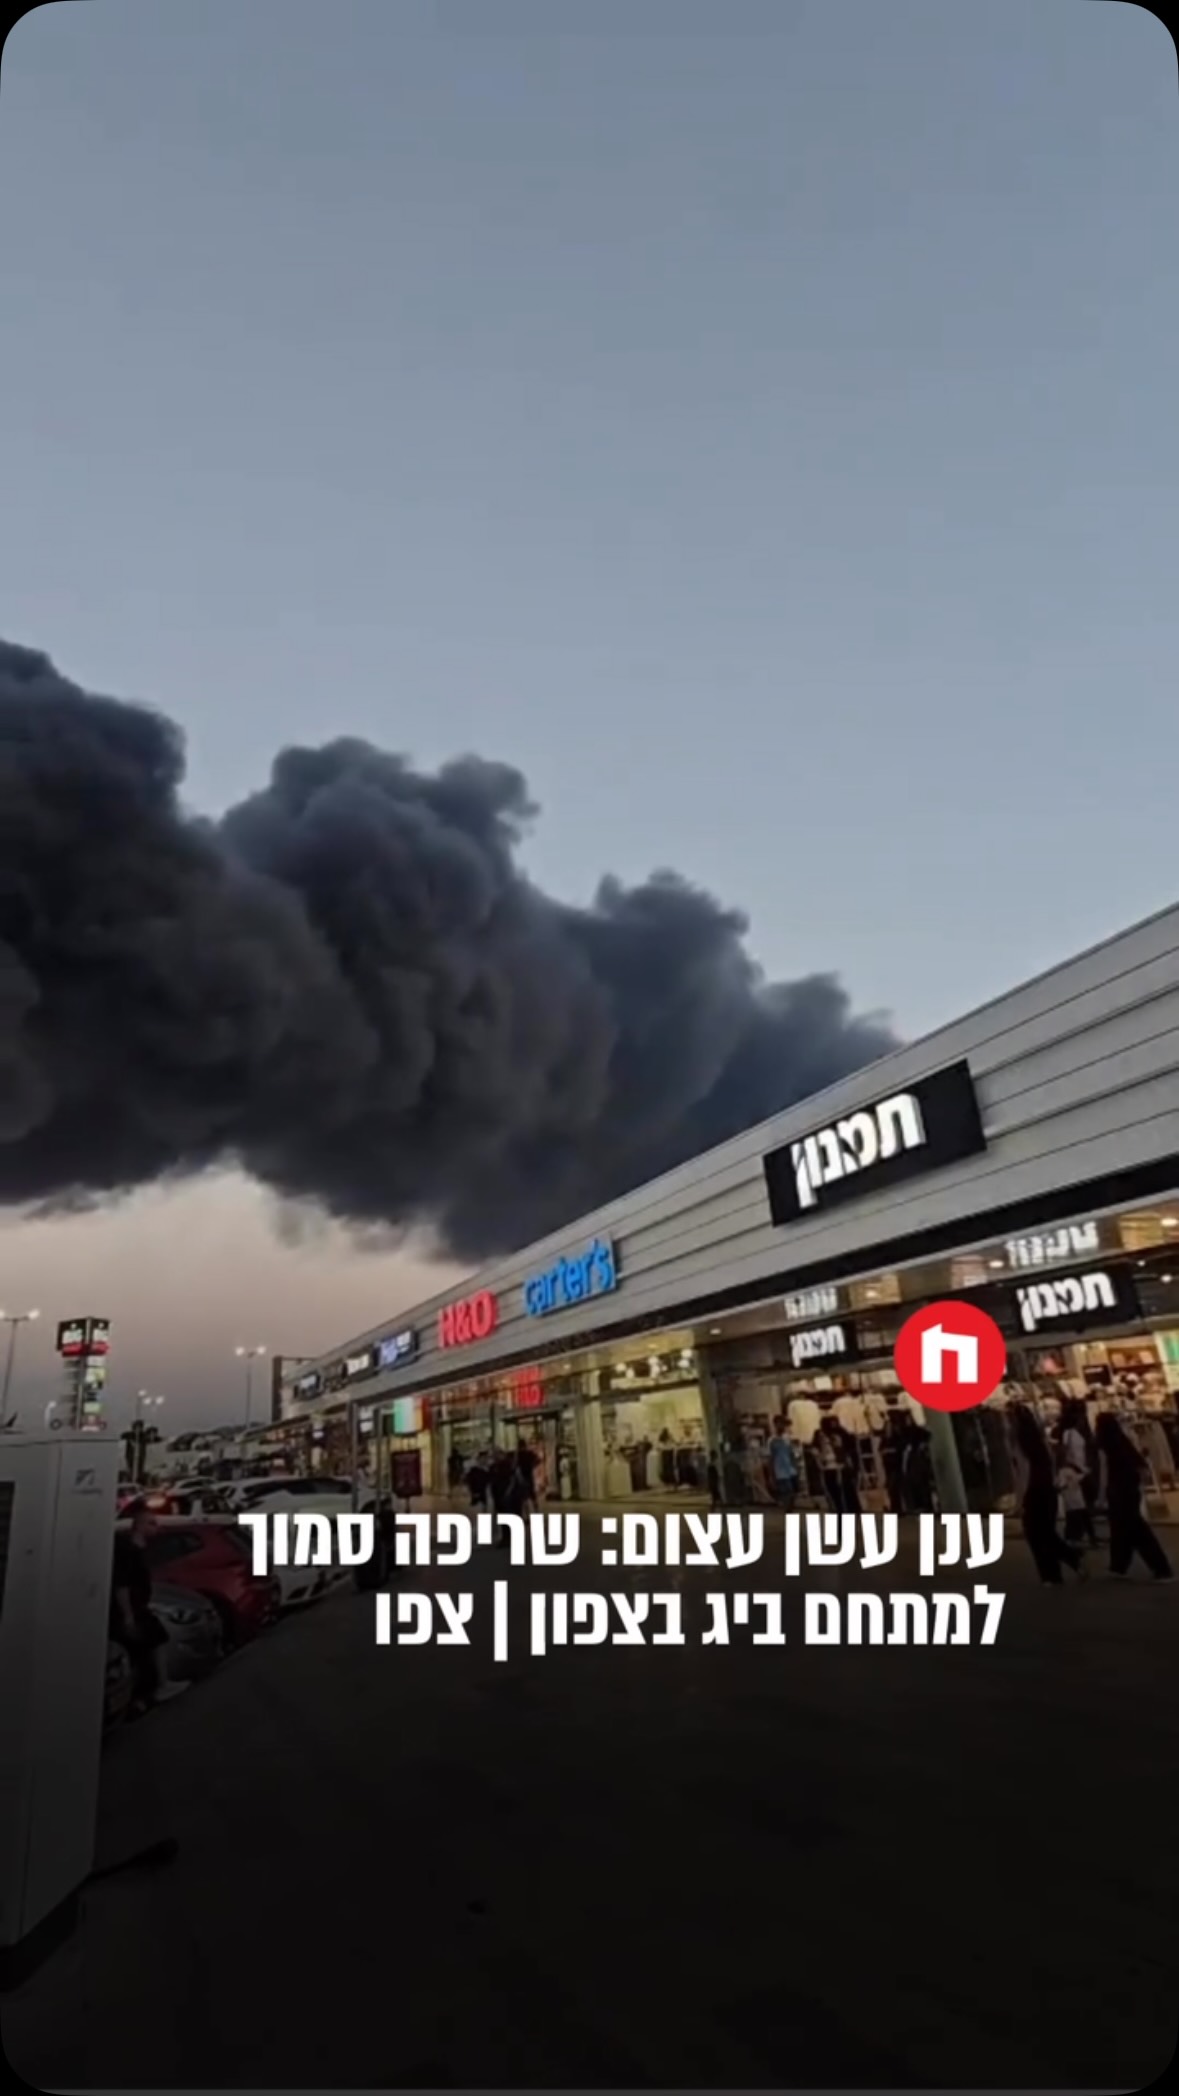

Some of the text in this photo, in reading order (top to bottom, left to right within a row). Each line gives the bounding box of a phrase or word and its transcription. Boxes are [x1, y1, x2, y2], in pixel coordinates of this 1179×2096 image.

[790, 1094, 925, 1208] תמנון
[525, 1238, 613, 1316] carter's
[1016, 1272, 1116, 1331] תמנון
[439, 1289, 497, 1348] H&O
[789, 1325, 846, 1367] תמנון
